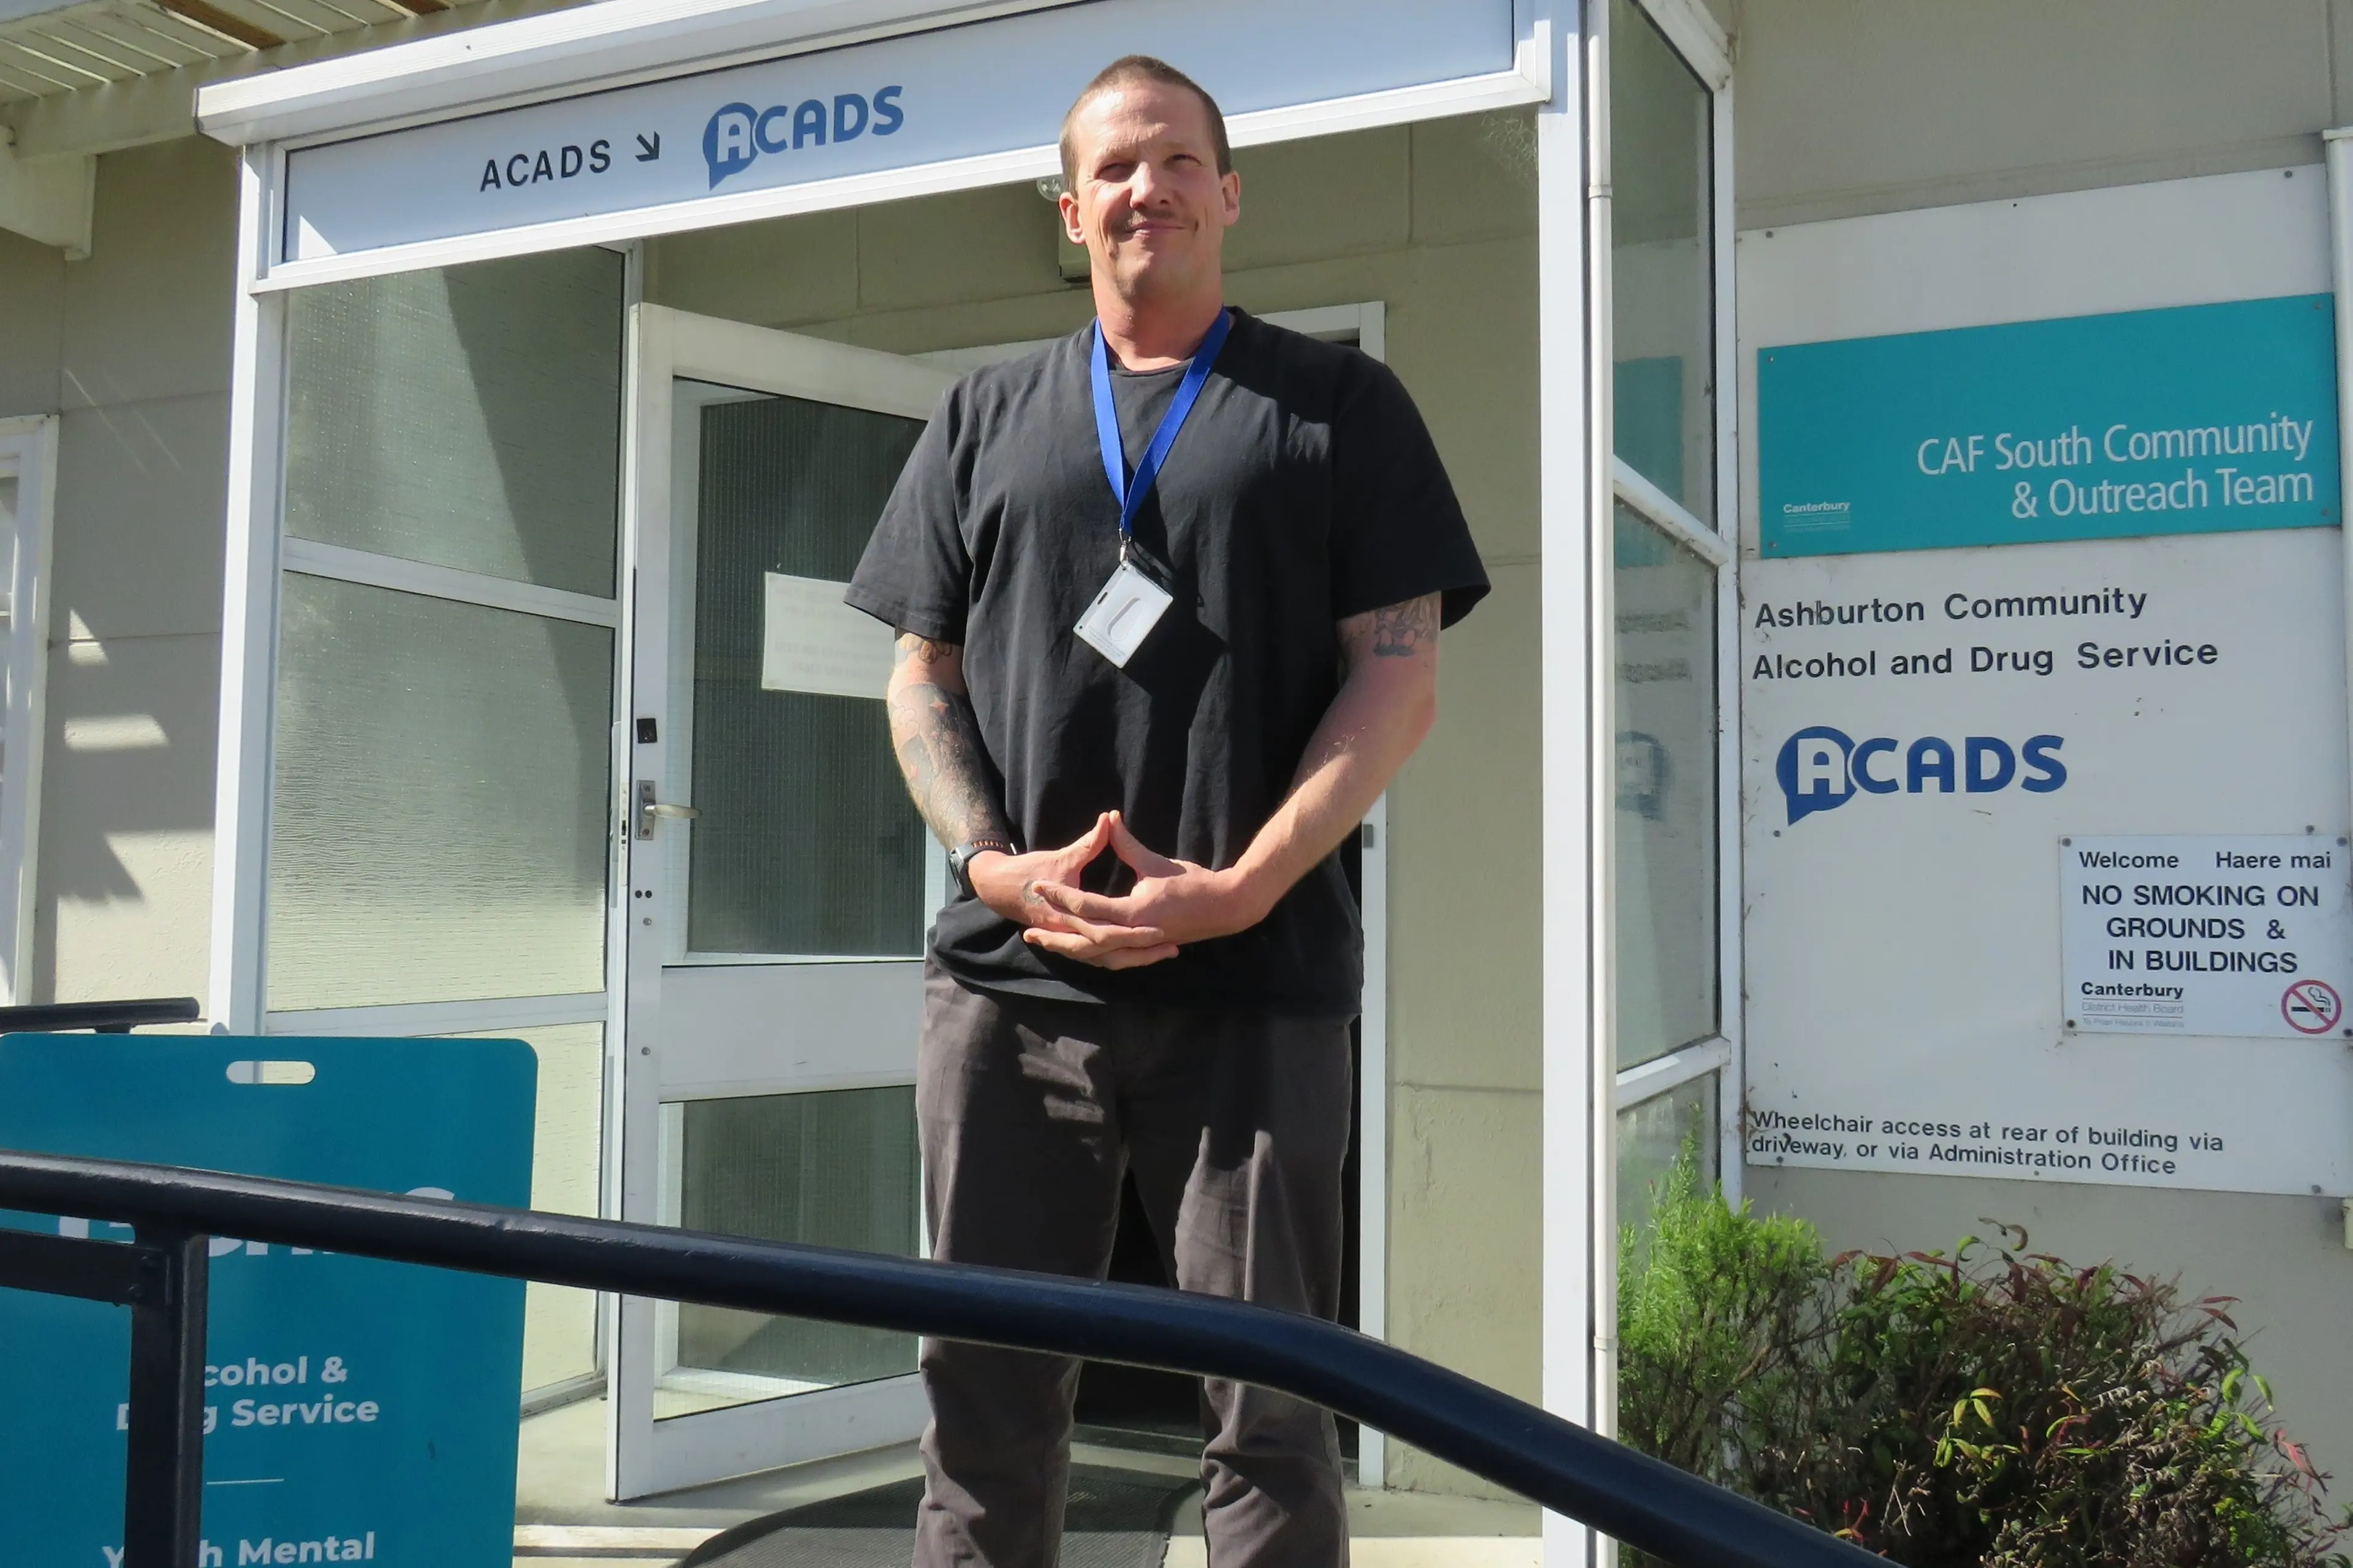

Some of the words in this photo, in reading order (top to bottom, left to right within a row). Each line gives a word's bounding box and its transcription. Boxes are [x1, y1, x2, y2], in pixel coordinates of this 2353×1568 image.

[717, 86, 904, 163] ACADS
[480, 140, 612, 192] ACADS
[1917, 435, 1985, 476] CAF
[1995, 426, 2091, 471] South
[2104, 411, 2313, 463] Community
[1783, 501, 1851, 513] Canterbury
[2012, 481, 2039, 518] &
[2048, 469, 2208, 516] Outreach
[2215, 468, 2313, 507] Team
[1755, 599, 1925, 628] Ashburton
[1944, 588, 2148, 621] Community
[1752, 650, 1876, 680] Alcohol
[1890, 647, 1952, 676] and
[1970, 645, 2054, 676] Drug
[2077, 638, 2219, 670] Service
[1796, 735, 2067, 795] ACADS
[2079, 850, 2179, 869] Welcome
[2216, 851, 2281, 869] Haere
[2290, 852, 2331, 869] mai
[2082, 885, 2122, 906] NO
[2133, 885, 2266, 906] SMOKING
[2277, 885, 2319, 907] ON
[2106, 917, 2245, 939] GROUNDS
[2267, 919, 2286, 939] &
[2109, 950, 2134, 970] IN
[2146, 950, 2297, 973] BUILDINGS
[2081, 982, 2184, 999] Canterbury
[2082, 1002, 2115, 1011] District
[2118, 1003, 2150, 1013] Health
[2153, 1004, 2184, 1013] Board
[1754, 1110, 1873, 1133] Wheelchair
[1882, 1119, 1961, 1138] access
[1969, 1122, 1990, 1139] at
[2002, 1126, 2048, 1142] rear
[2055, 1126, 2079, 1143] of
[2088, 1127, 2178, 1153] building
[2189, 1132, 2224, 1151] via
[1857, 1143, 1878, 1157] or
[1889, 1142, 1919, 1159] via
[1929, 1143, 2091, 1169] Administration
[2101, 1153, 2176, 1174] Office
[204, 1356, 308, 1387] cohol
[321, 1356, 348, 1384] &
[231, 1393, 380, 1427] Service
[238, 1531, 375, 1567] Mental
